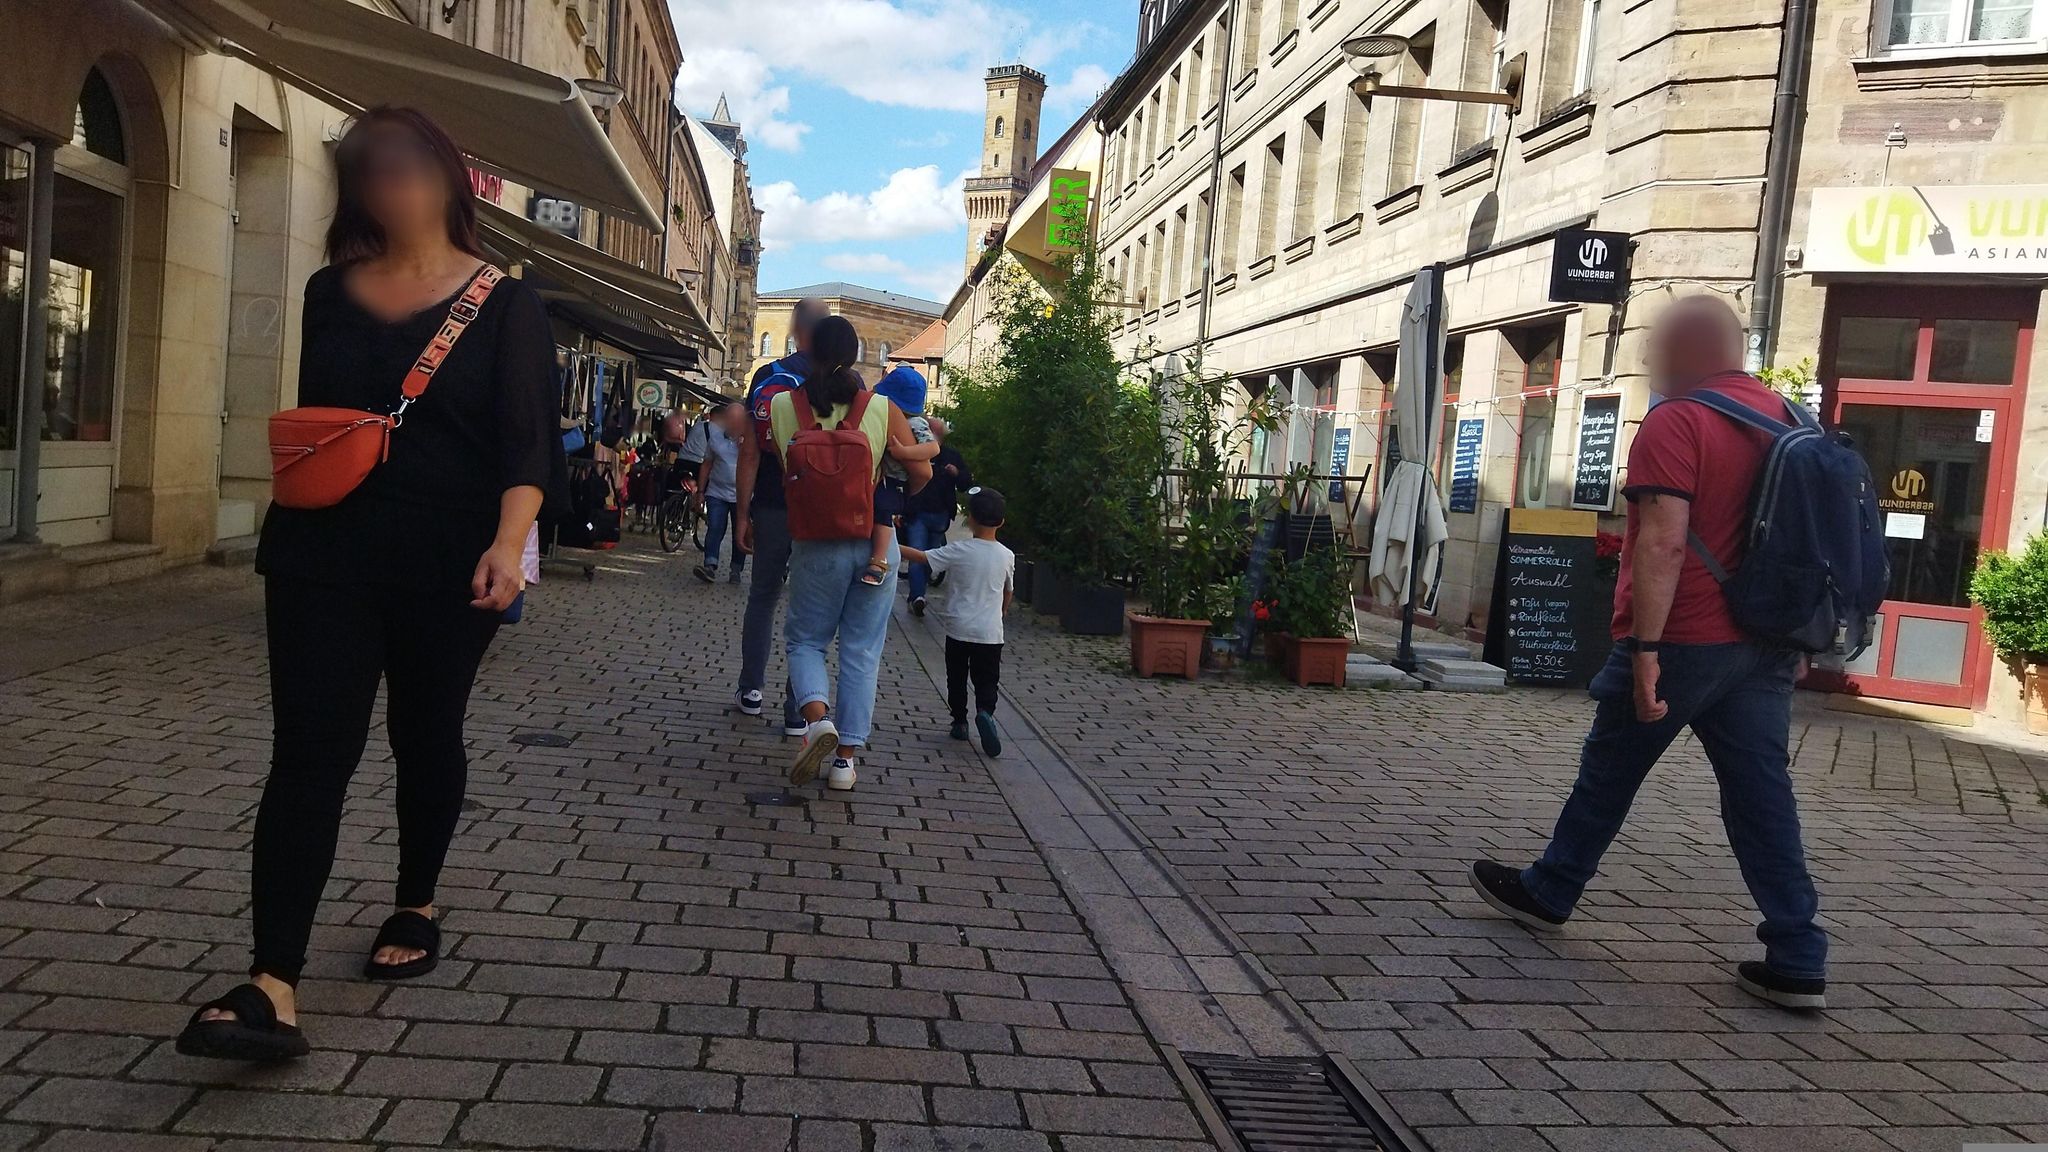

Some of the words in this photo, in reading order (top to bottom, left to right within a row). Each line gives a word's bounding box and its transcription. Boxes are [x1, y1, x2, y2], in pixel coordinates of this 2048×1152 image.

[1967, 247, 2048, 259] ASIAN
[1567, 268, 1615, 279] VUNDERBAR
[1879, 499, 1934, 510] VUNDERBAR
[1509, 555, 1573, 567] SOMMERROLLE
[1510, 571, 1573, 588] Auswahl
[1520, 597, 1540, 611] Tofu
[1544, 598, 1570, 610] (vegan)
[1517, 610, 1567, 626] Rindfleisch
[1516, 626, 1553, 638] Garnelen
[1556, 628, 1573, 638] und
